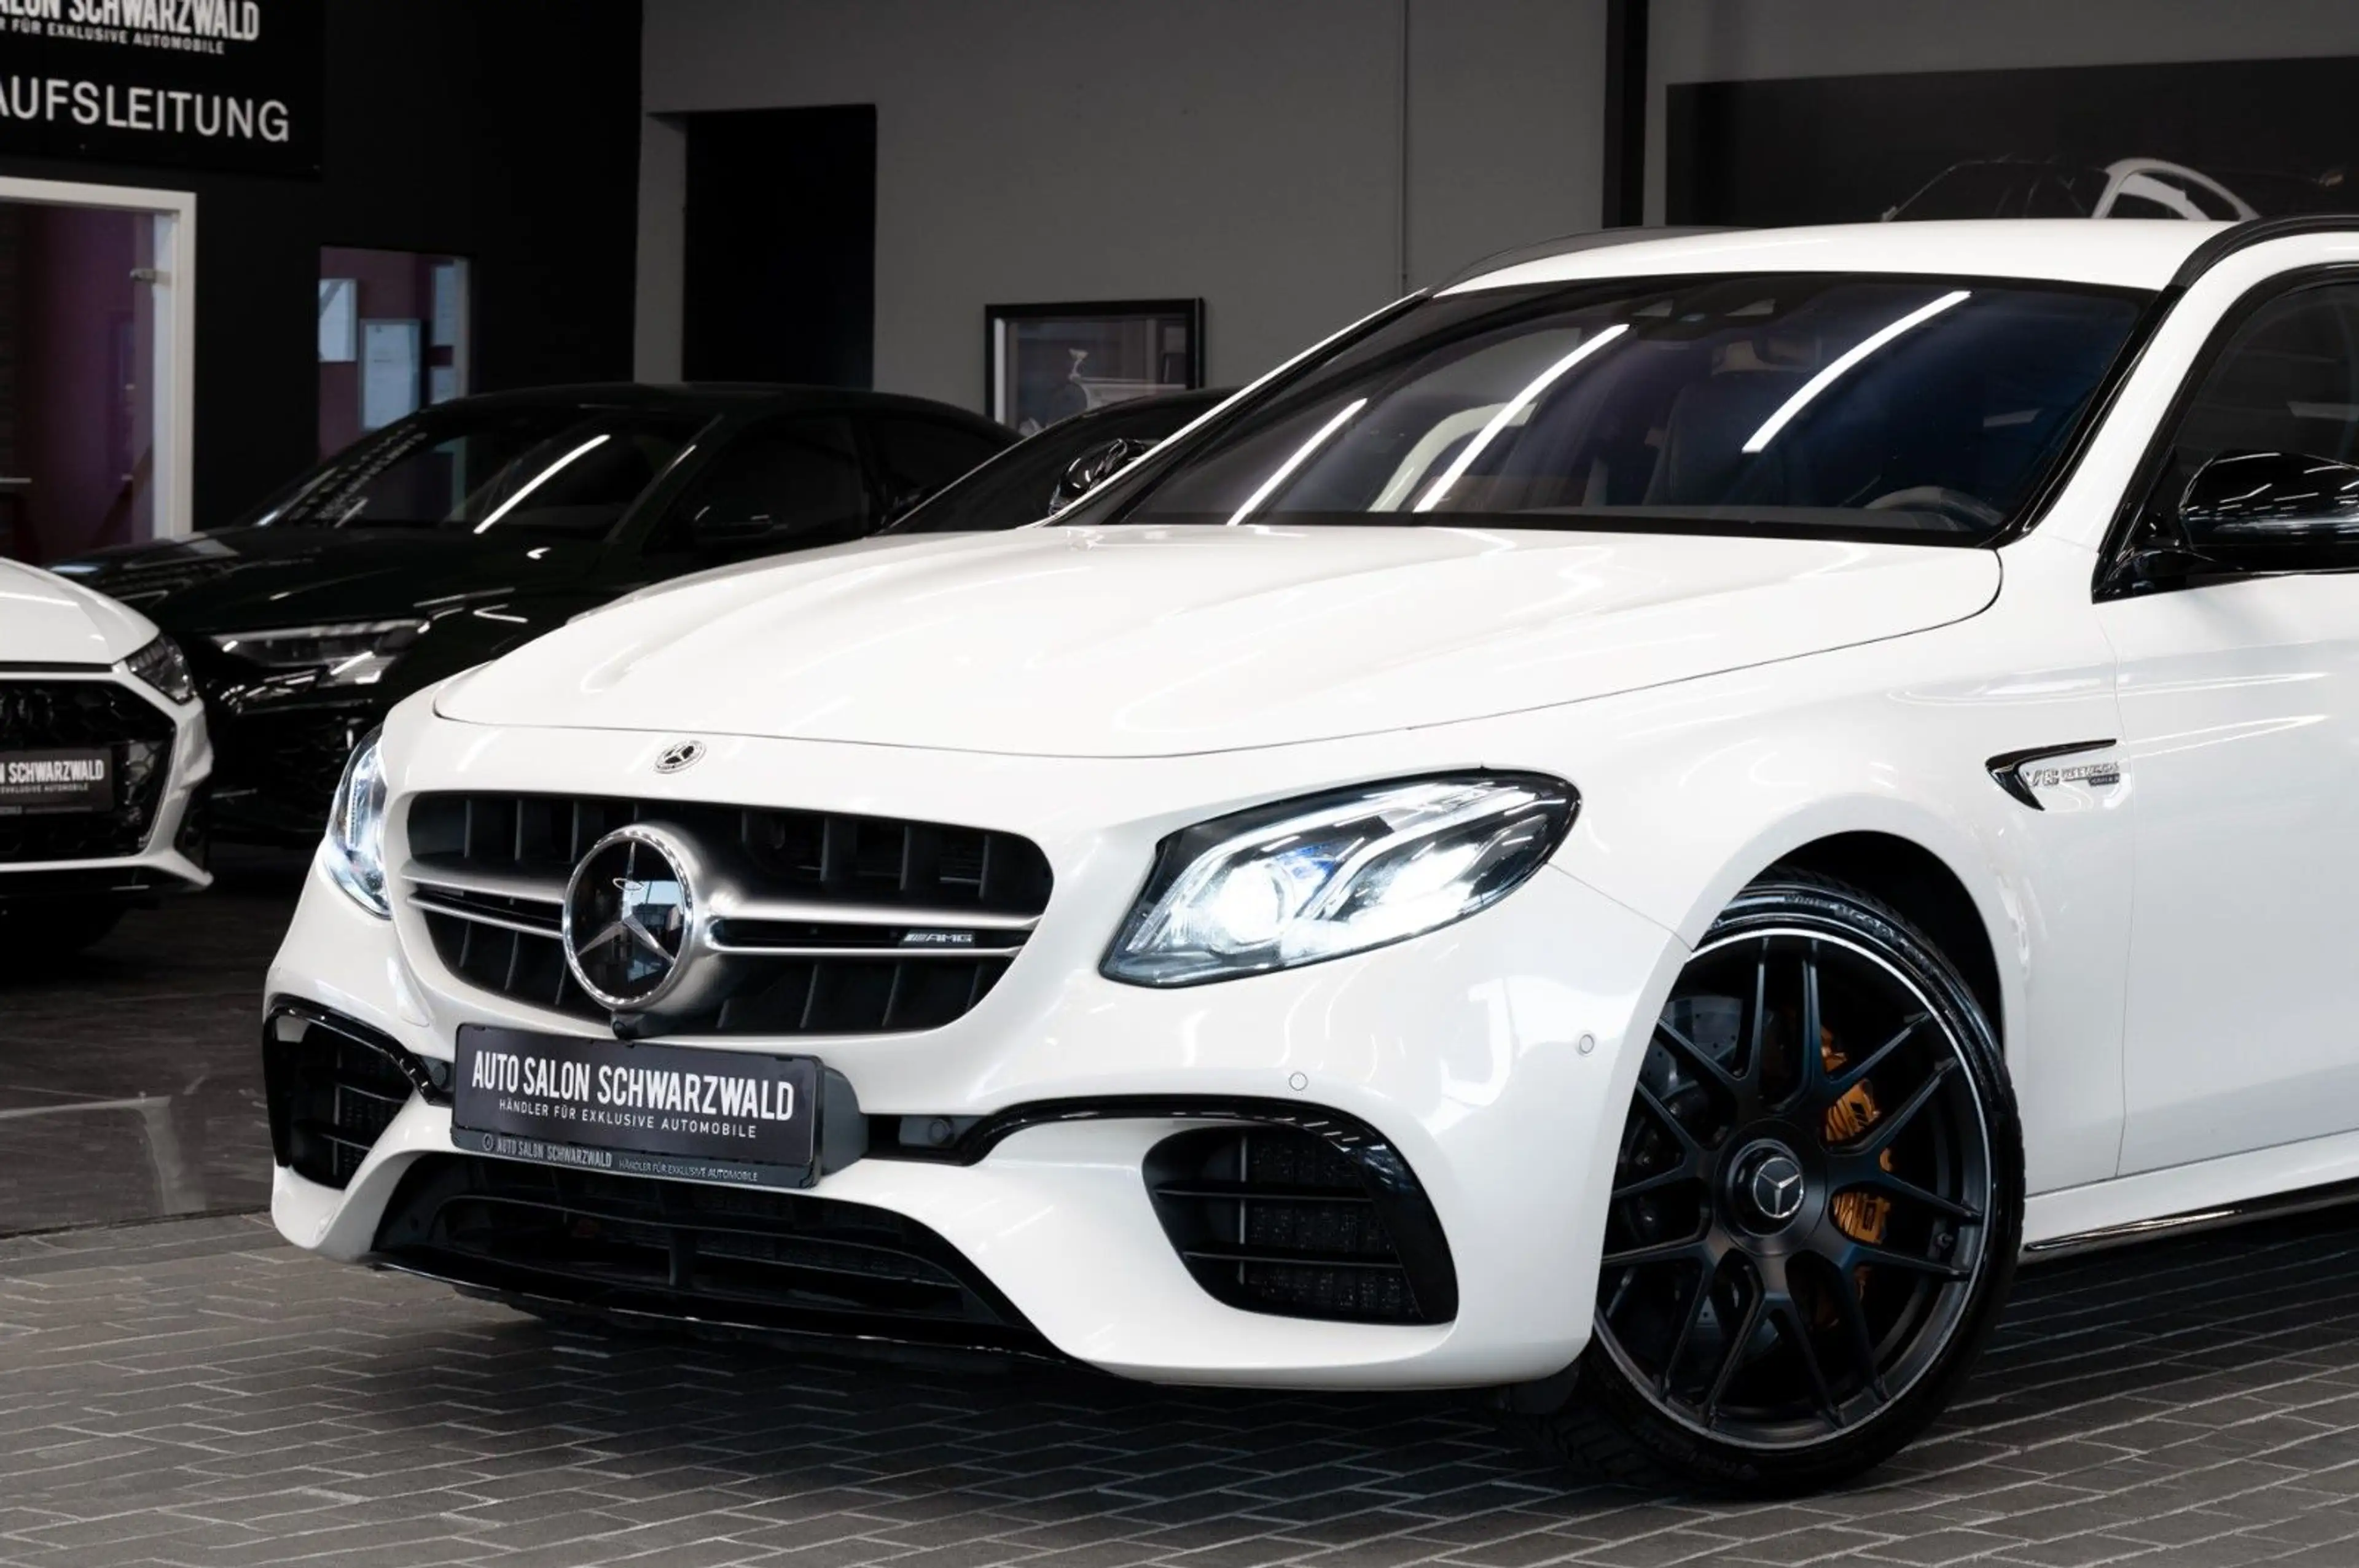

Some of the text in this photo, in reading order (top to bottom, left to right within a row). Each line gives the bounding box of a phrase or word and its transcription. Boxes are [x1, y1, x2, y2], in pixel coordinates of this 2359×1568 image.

[47, 21, 127, 44] EXKLUSIVE
[133, 31, 225, 55] AUTOMOBILE
[8, 759, 104, 784] SCHWARZWALD
[471, 1050, 794, 1121] AUTO SALON SCHWARZWALD
[499, 1097, 758, 1139] HÄNDLER FÜR EXKLUSIVE AUTOMOBILE
[496, 1137, 613, 1168] AUTO SALON SCHWARZWALD
